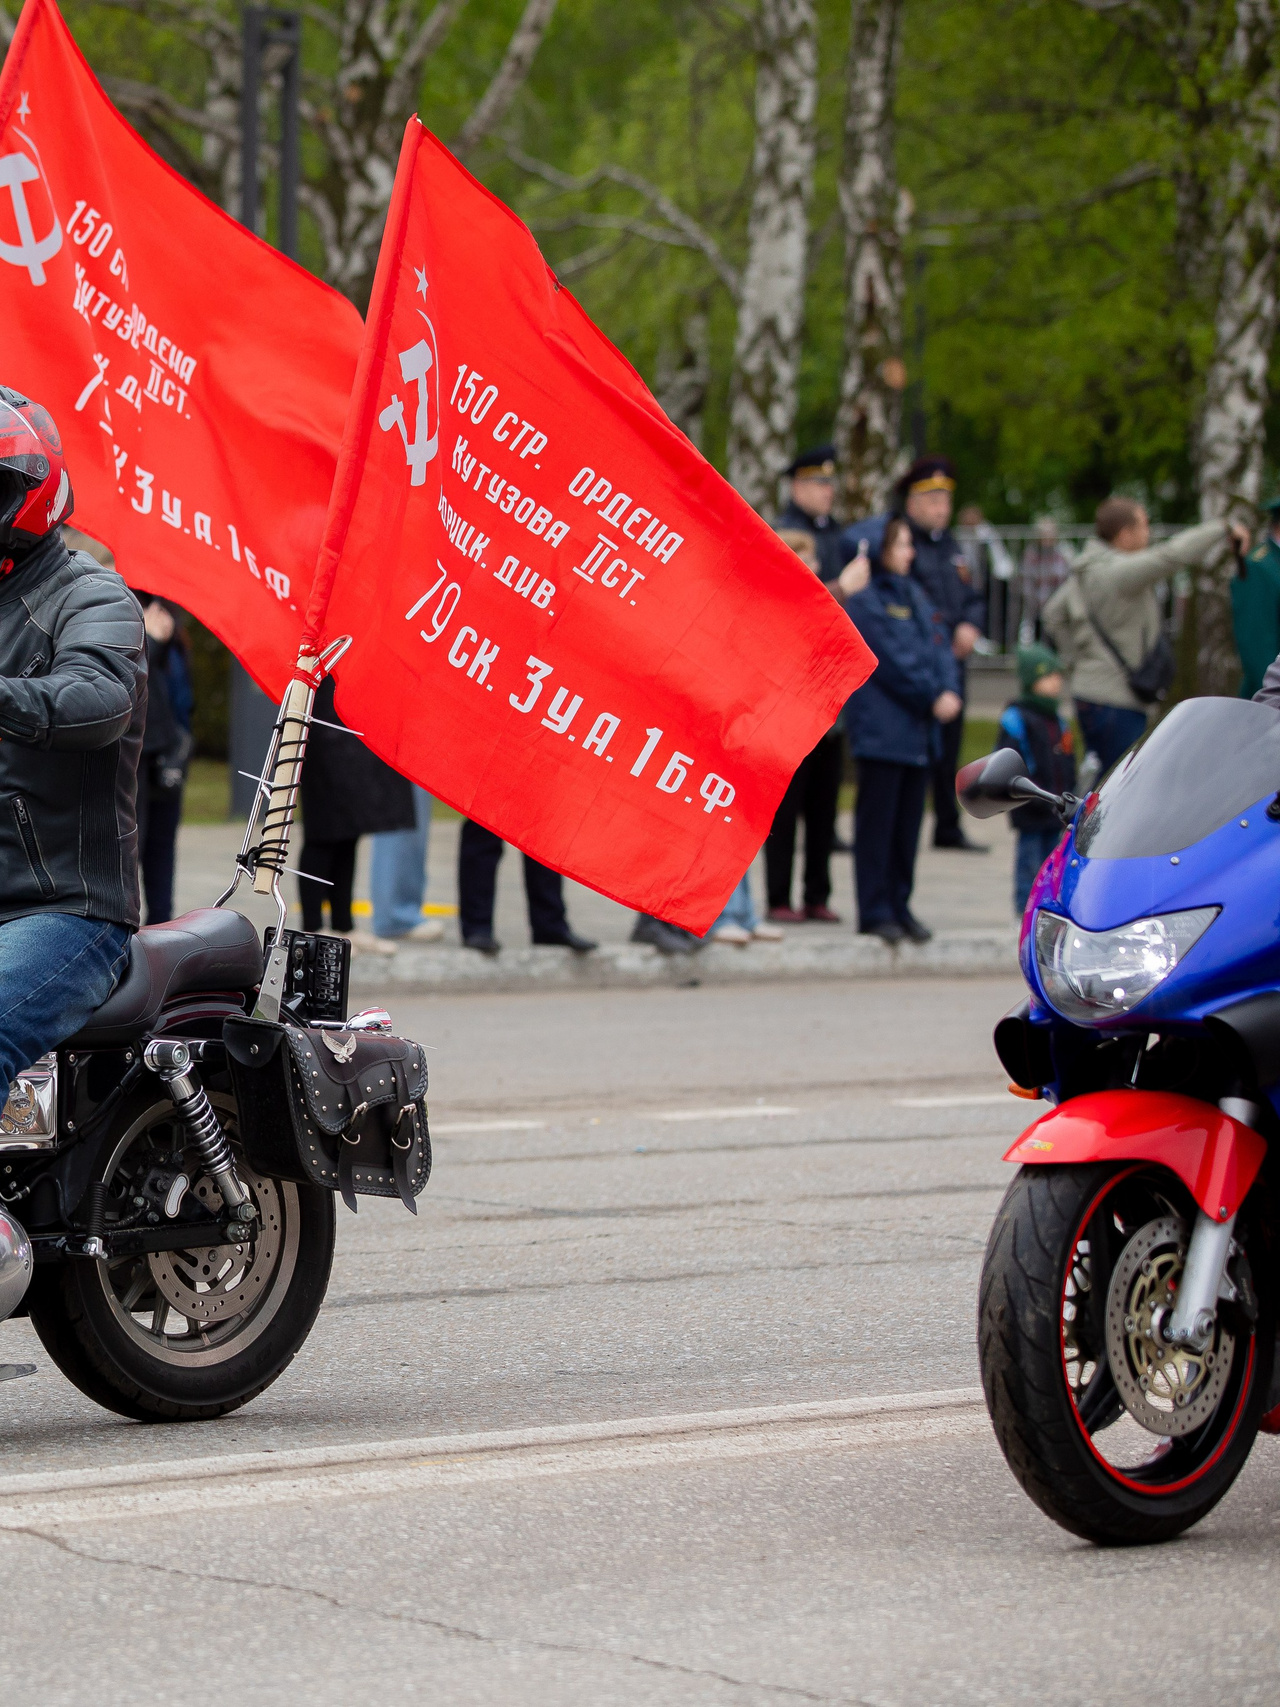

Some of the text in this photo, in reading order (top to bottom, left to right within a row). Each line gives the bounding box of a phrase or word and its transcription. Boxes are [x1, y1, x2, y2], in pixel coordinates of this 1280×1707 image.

[66, 200, 113, 258] 150
[449, 363, 685, 565] 150 СТР. ОРДЕНА
[451, 434, 571, 549] КУТУЗОВА
[492, 555, 556, 617] ДИВ.
[404, 559, 462, 643] 79
[447, 625, 501, 692] СК.
[655, 750, 736, 823] Б.Ф.
